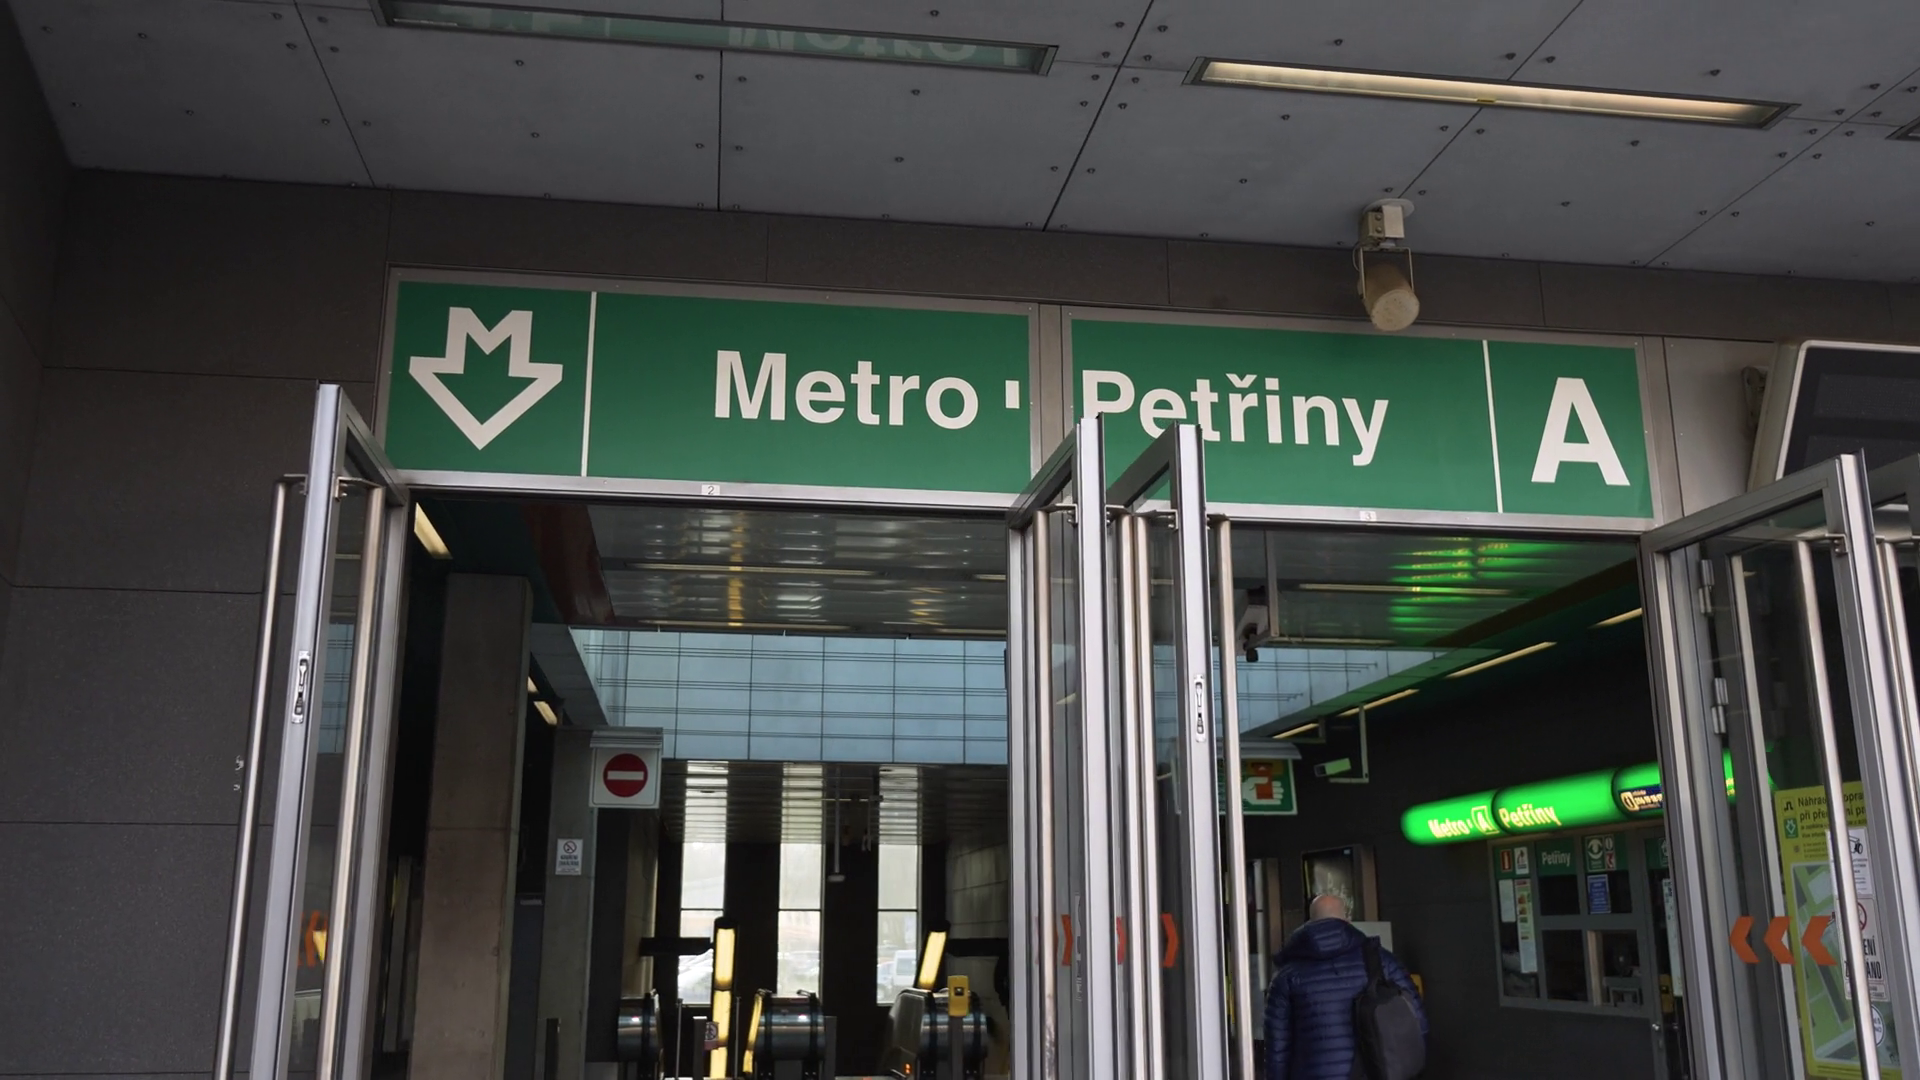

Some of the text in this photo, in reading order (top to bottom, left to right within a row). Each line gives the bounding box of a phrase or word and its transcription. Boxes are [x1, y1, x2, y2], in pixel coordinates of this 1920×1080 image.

[715, 350, 1631, 487] Metro Petřiny A
[707, 485, 715, 495] 2
[1364, 511, 1372, 520] 3
[1428, 818, 1470, 839] Metro
[1498, 804, 1563, 829] Petřiny
